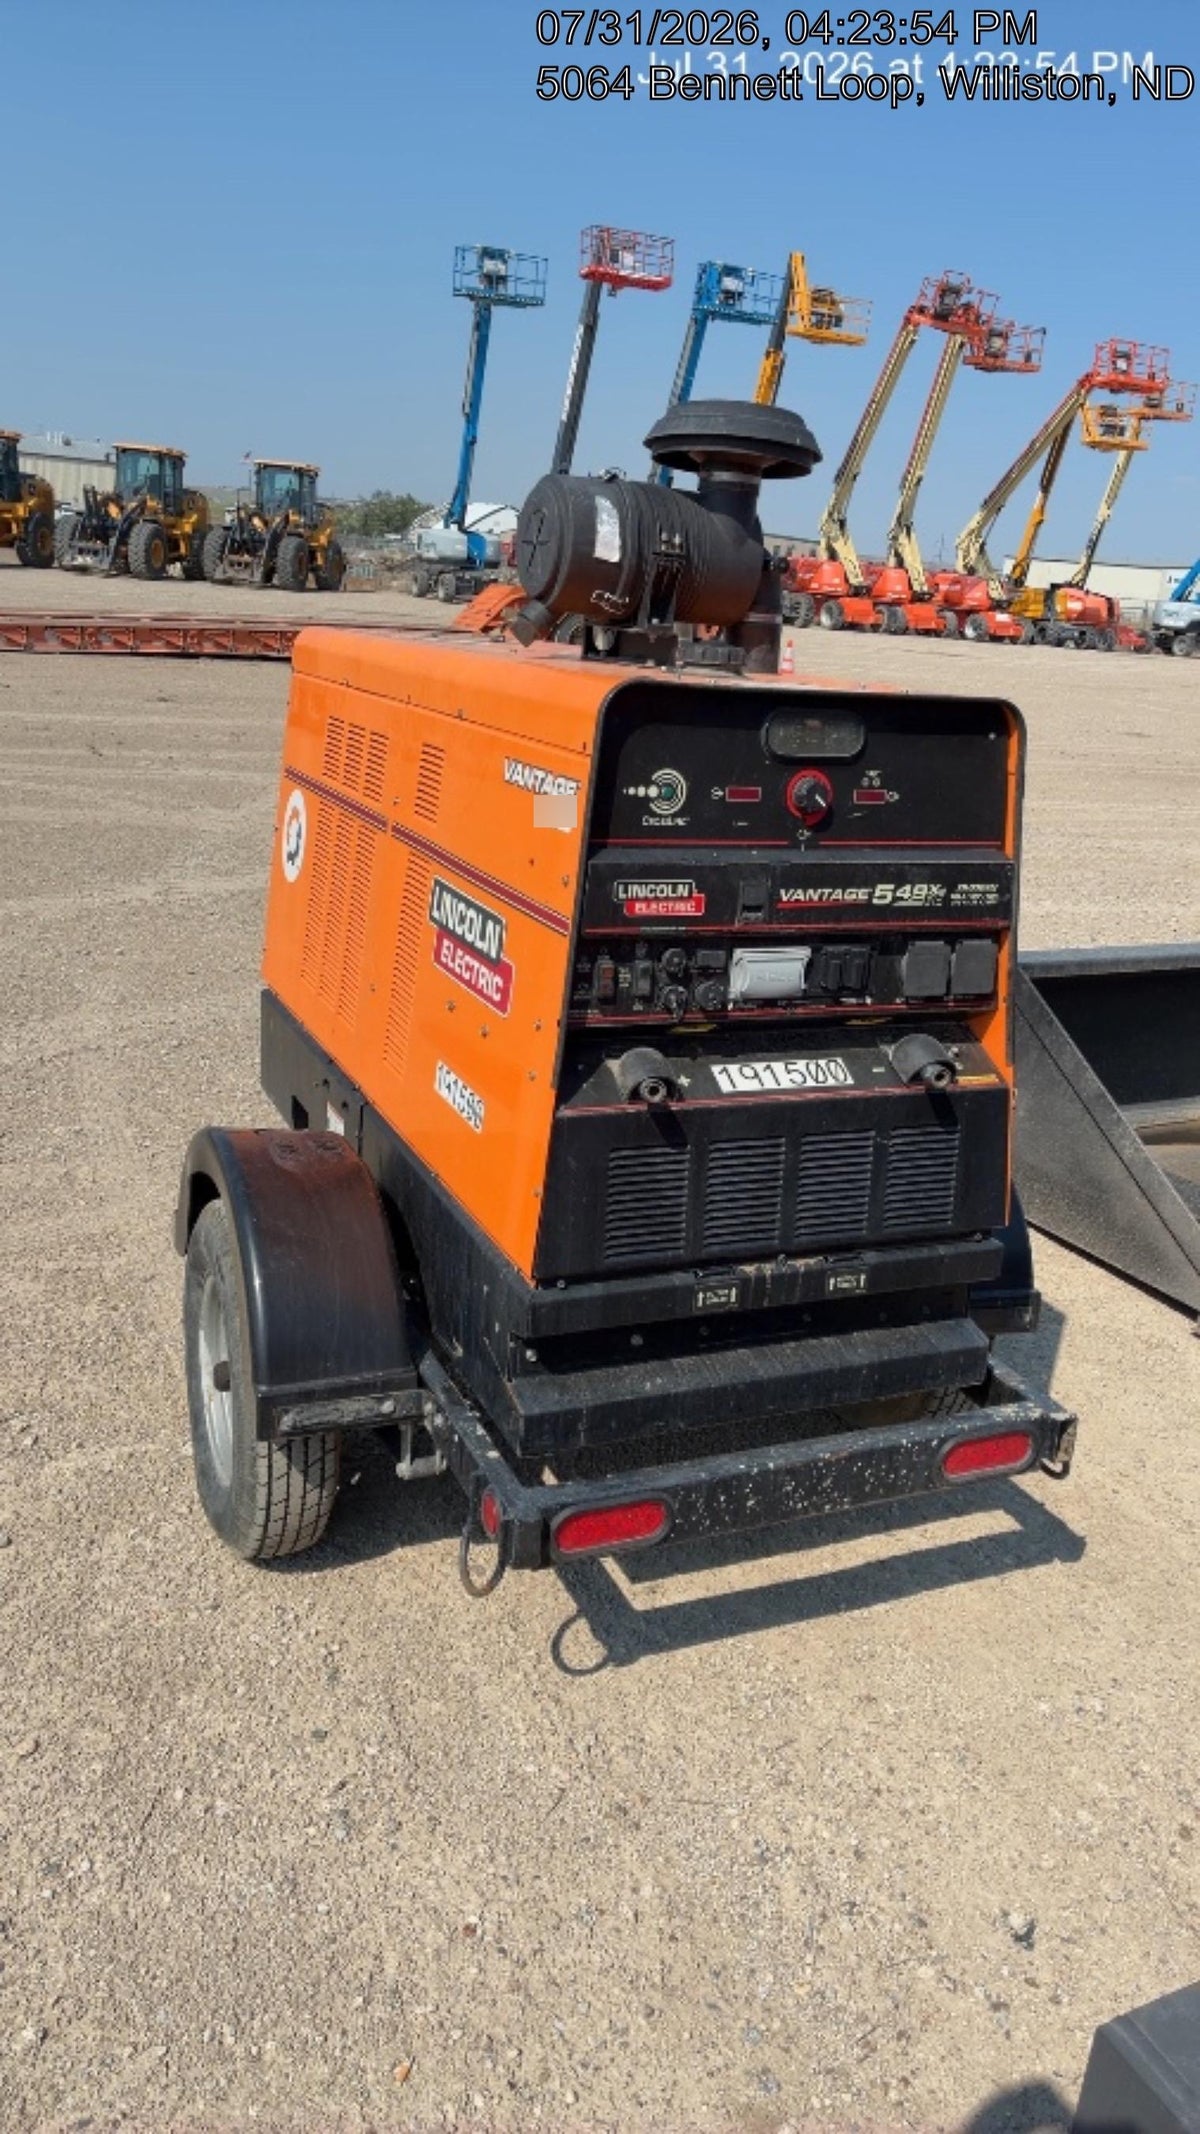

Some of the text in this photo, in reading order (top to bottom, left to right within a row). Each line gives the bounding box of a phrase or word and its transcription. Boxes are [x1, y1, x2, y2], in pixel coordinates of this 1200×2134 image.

[618, 884, 689, 899] LINCOLN
[779, 887, 872, 902] VANTAGE
[431, 886, 502, 960] LINCOLN
[440, 937, 504, 1002] ELECTRIC
[718, 1059, 849, 1089] 191500
